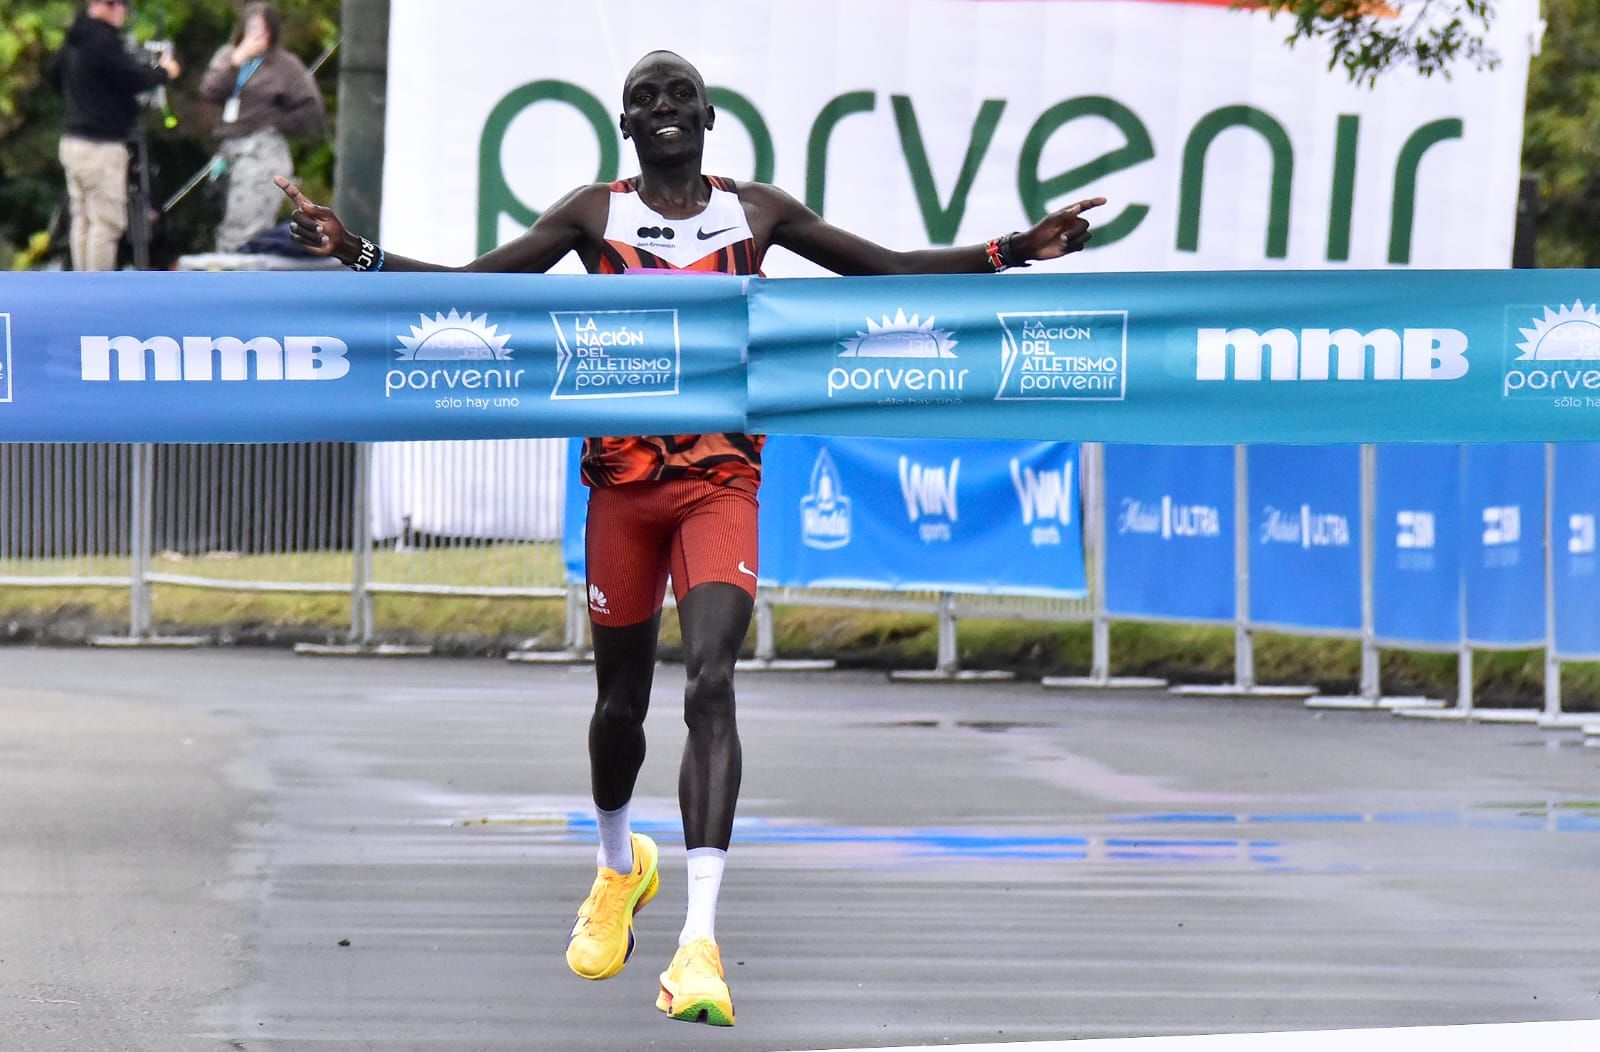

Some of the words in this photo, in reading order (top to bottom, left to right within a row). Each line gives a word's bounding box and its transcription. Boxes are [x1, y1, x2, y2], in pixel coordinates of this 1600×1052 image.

[352, 236, 375, 270] RICK
[575, 317, 598, 331] LA
[1023, 320, 1045, 329] LA
[575, 326, 644, 346] NACIÓN
[1022, 325, 1091, 340] NACIÓN
[576, 347, 610, 358] DEL
[1022, 340, 1056, 356] DEL
[1196, 328, 1470, 381] mmB
[80, 335, 350, 381] mmB
[576, 357, 672, 371] ATLETISMO
[1021, 357, 1118, 372] ATLETISMO
[385, 369, 526, 398] porvenir
[575, 373, 672, 391] porvenir
[828, 367, 970, 398] porvenir
[1020, 374, 1118, 395] porvenir
[435, 396, 462, 409] sólo
[466, 396, 490, 410] hay
[494, 397, 520, 407] uno
[1553, 396, 1582, 408] sólo
